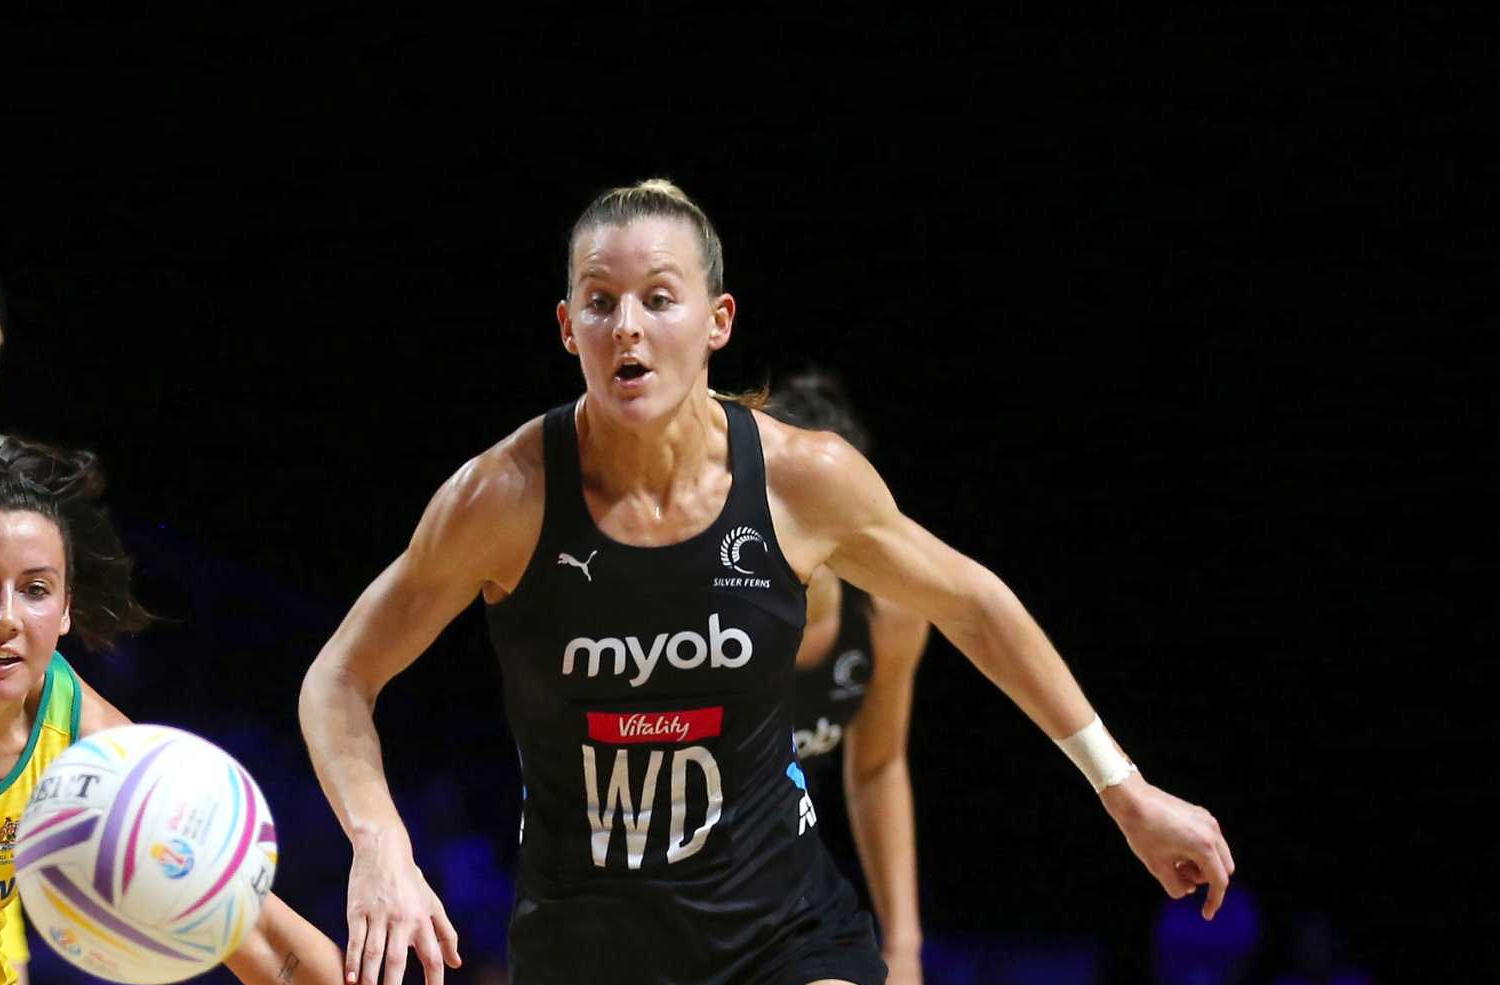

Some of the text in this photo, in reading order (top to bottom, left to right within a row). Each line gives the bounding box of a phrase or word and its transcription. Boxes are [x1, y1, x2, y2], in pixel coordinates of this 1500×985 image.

[713, 577, 771, 589] SILVER FERNS
[562, 613, 753, 688] myob
[619, 713, 690, 742] Vitality
[581, 744, 724, 870] WD
